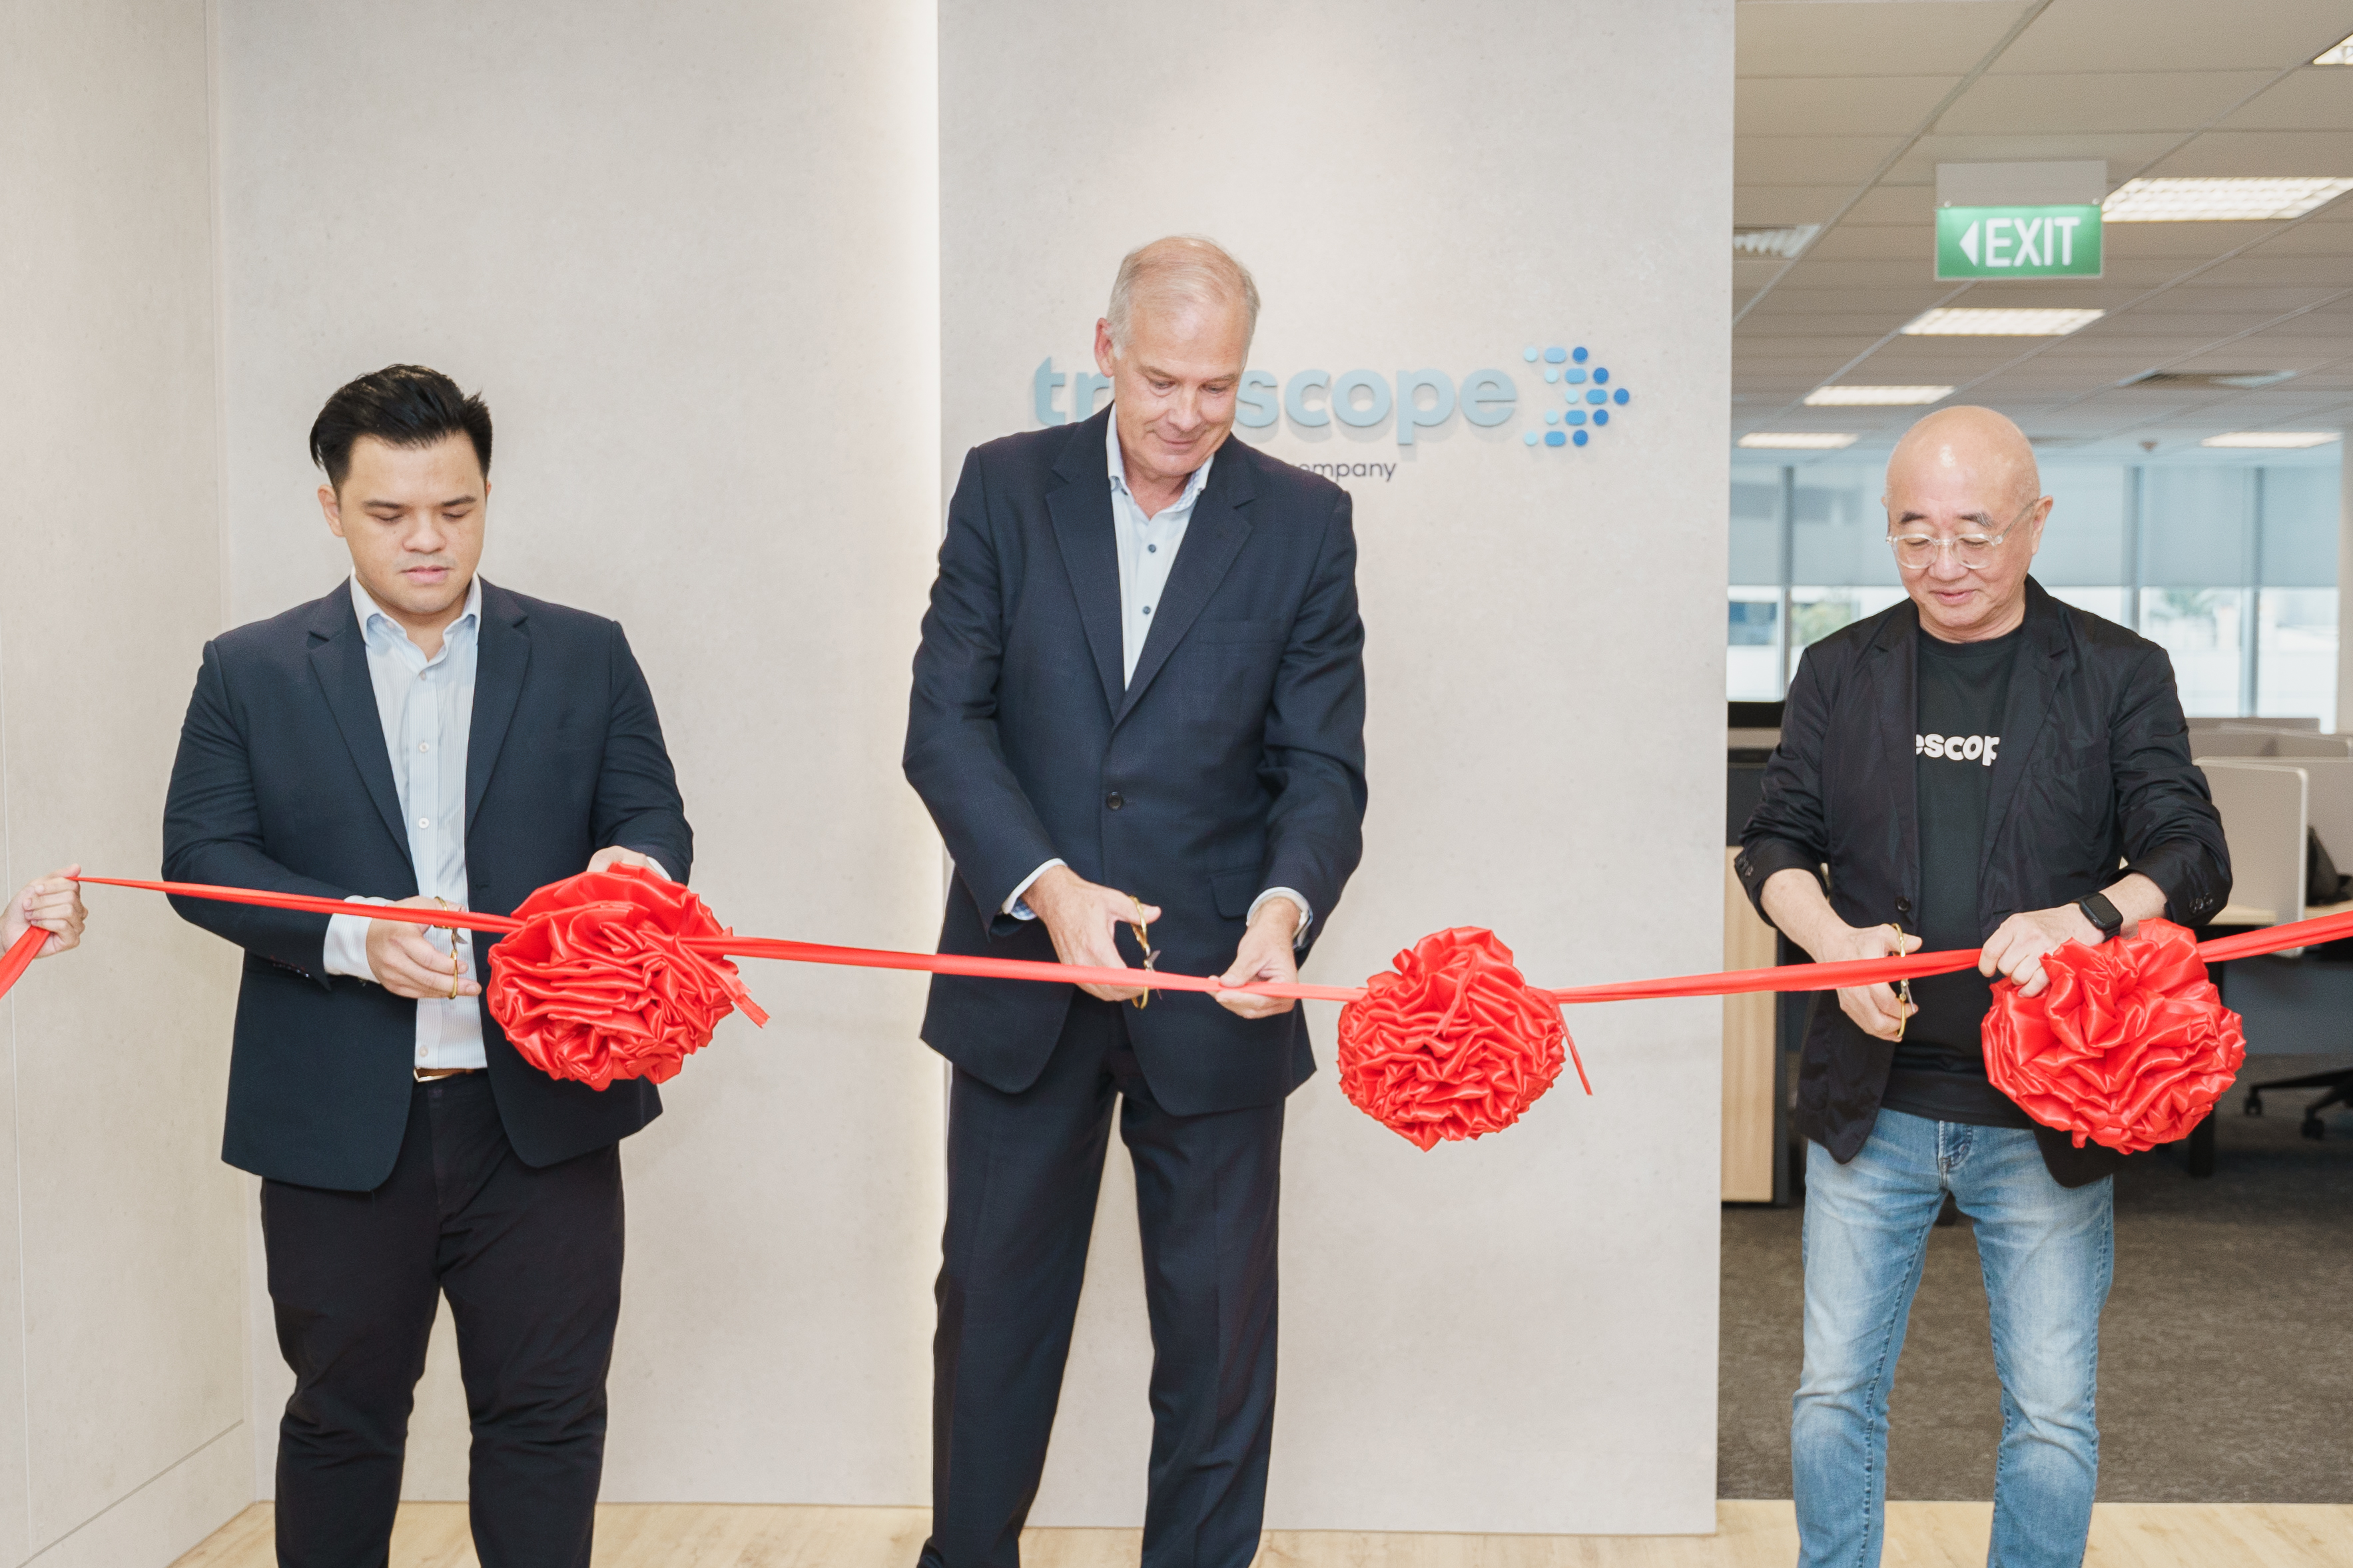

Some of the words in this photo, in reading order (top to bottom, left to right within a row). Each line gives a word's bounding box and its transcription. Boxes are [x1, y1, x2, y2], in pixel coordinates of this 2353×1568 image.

[1985, 216, 2081, 267] EXIT
[1034, 356, 1517, 445] trscope
[1292, 463, 1396, 482] mpany
